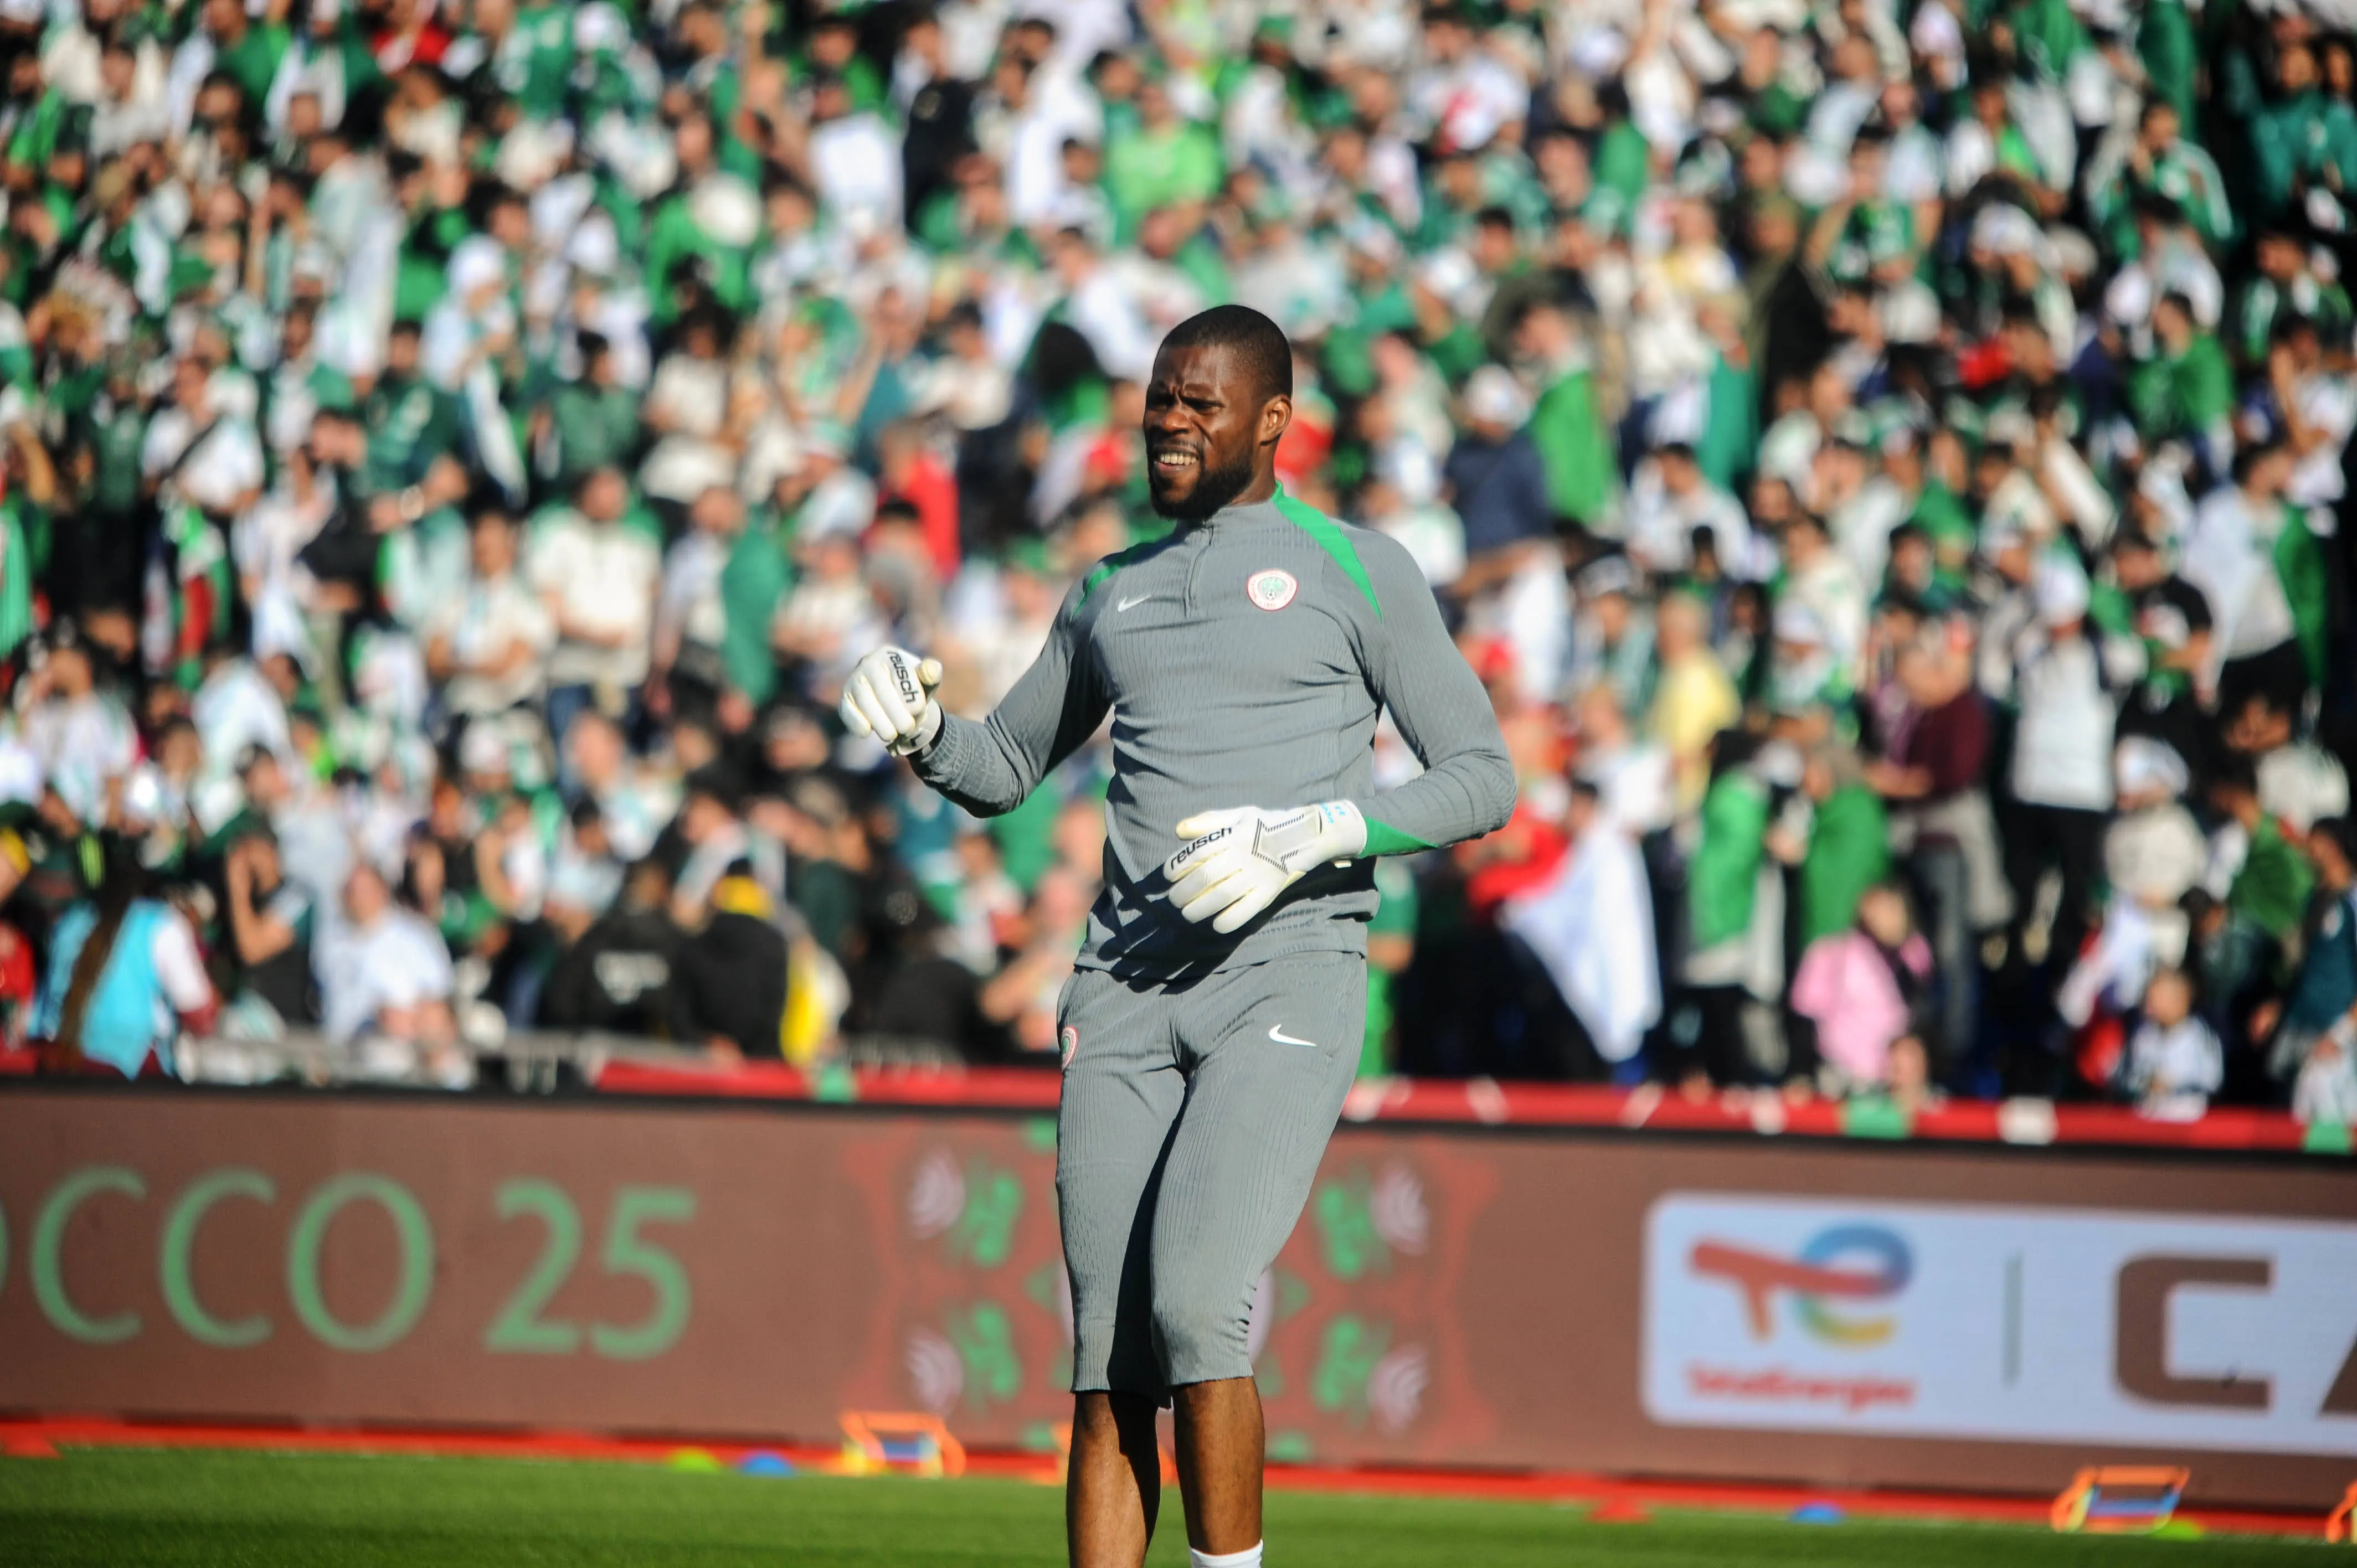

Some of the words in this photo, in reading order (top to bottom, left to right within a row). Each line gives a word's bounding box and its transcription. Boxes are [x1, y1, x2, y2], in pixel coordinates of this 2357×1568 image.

[887, 651, 919, 704] reusch
[1170, 827, 1232, 871] reusch
[0, 1163, 435, 1352] CCO
[485, 1176, 697, 1361] 25
[2112, 1250, 2357, 1419] C
